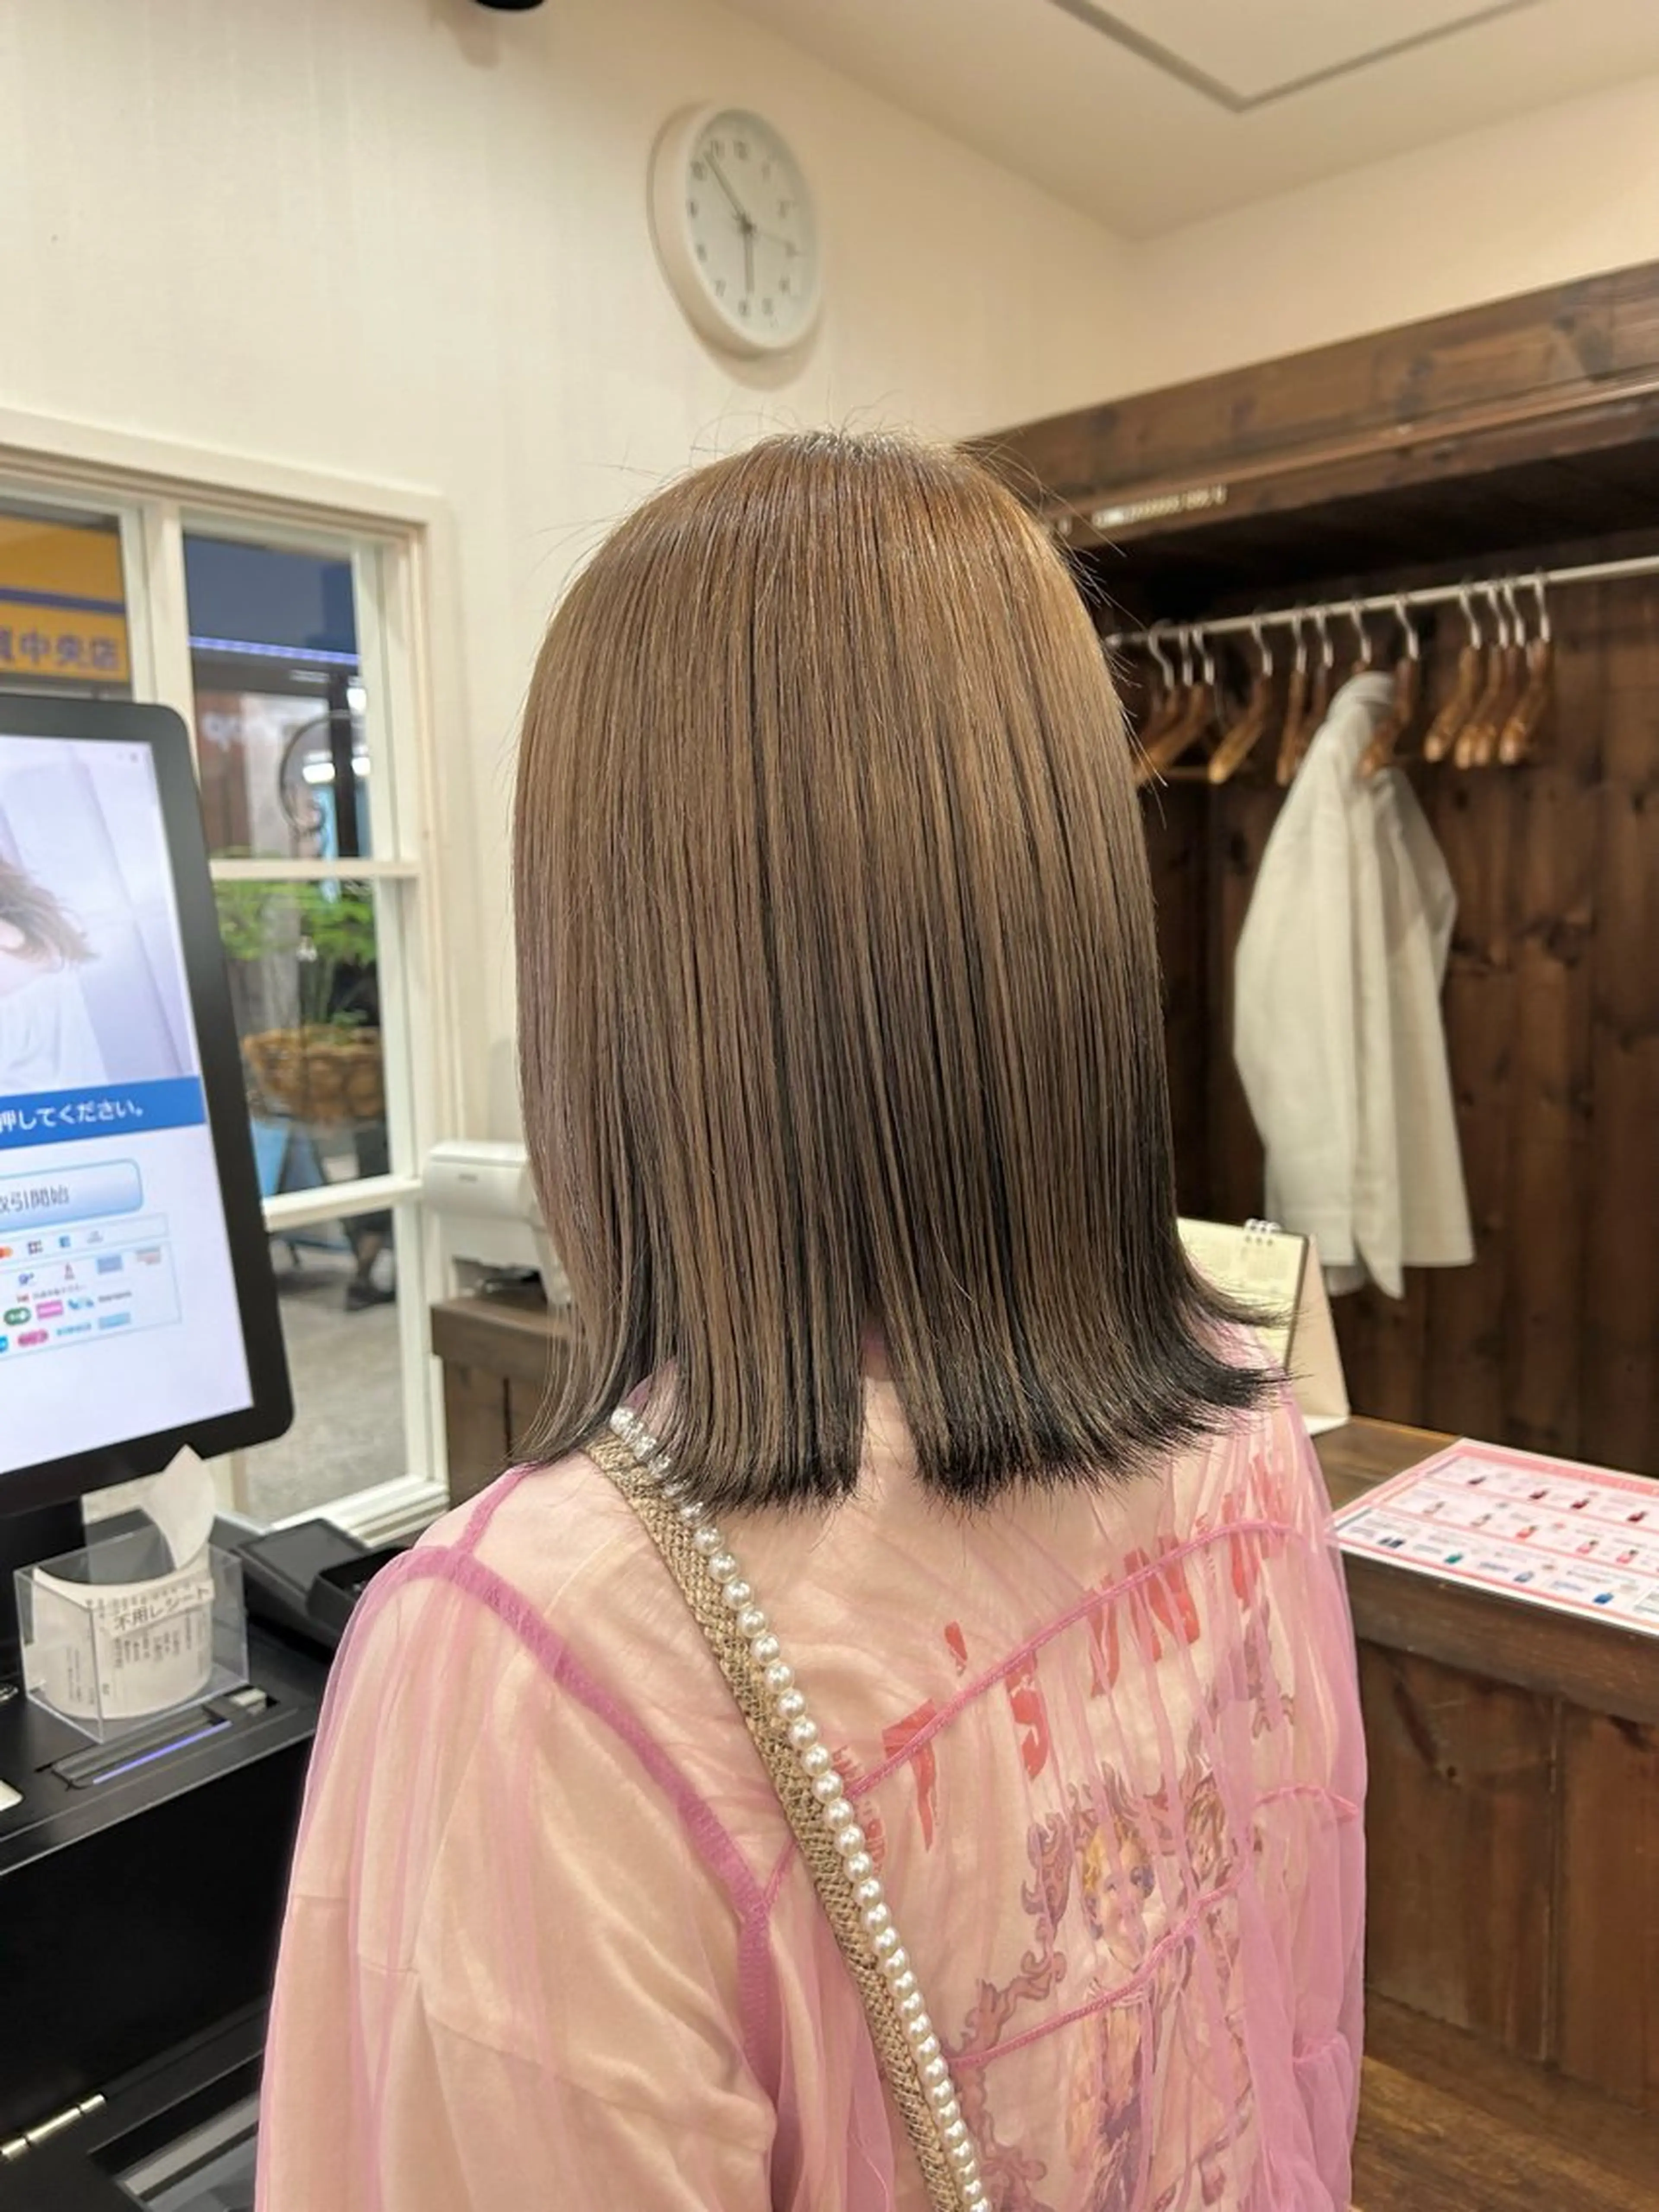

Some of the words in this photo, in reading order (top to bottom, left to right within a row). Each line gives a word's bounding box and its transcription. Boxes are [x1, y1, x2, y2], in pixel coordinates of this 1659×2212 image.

[113, 1587, 210, 1631] 不用レシート
